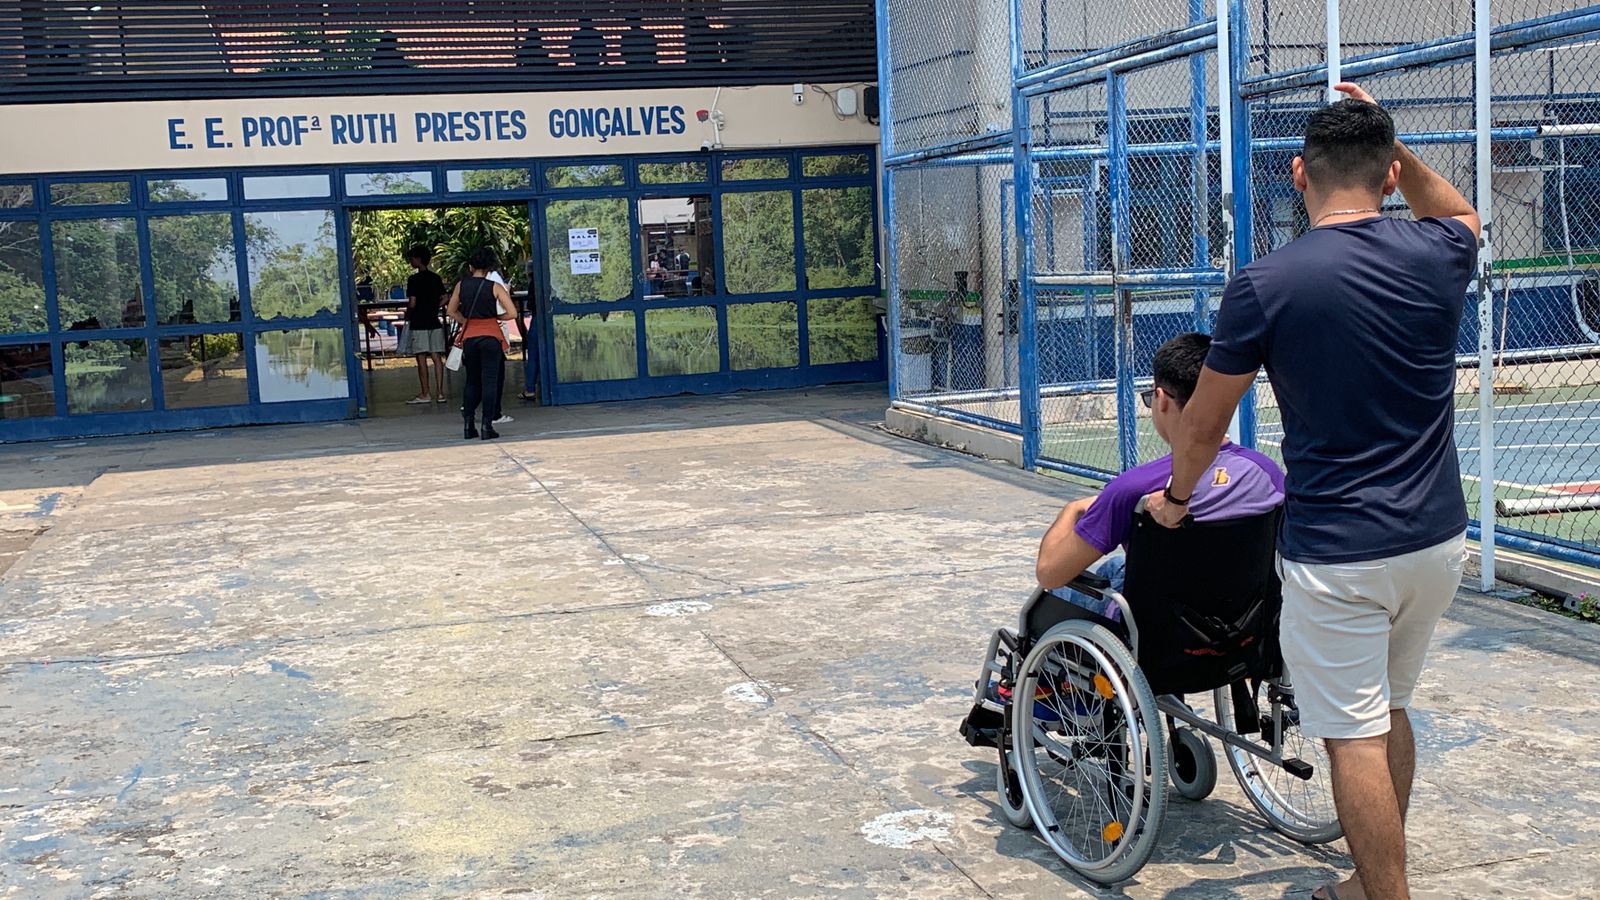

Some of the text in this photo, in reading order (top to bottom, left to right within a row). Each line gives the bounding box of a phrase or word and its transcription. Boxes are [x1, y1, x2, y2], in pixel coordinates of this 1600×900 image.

[168, 119, 193, 149] E.
[205, 118, 233, 148] E.
[331, 113, 397, 144] RUTH
[415, 110, 526, 142] PRESTES
[549, 106, 685, 143] GONÇALVES
